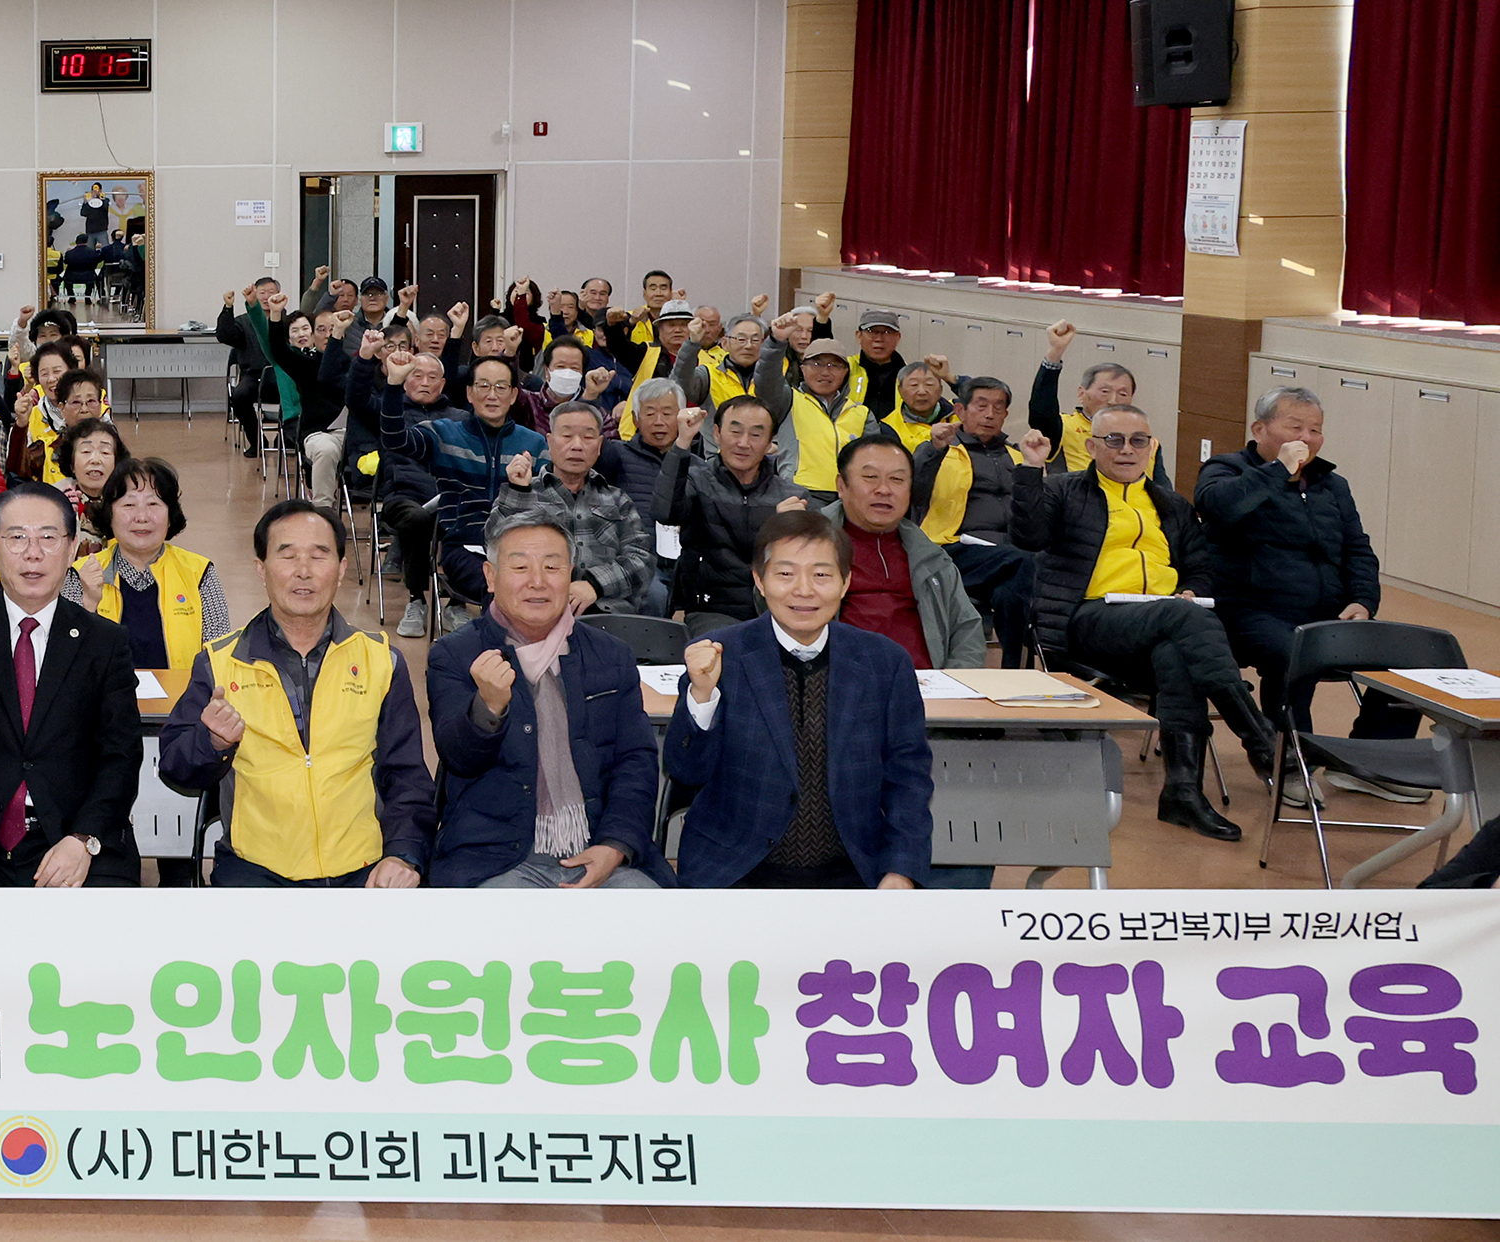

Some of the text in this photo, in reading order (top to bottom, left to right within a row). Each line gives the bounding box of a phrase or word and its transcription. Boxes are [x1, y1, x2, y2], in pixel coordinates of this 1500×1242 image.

[1214, 126, 1220, 136] 3
[1120, 911, 1271, 942] 보건복지부
[24, 959, 1480, 1096] 노인자원봉사 참여자 교육
[65, 1128, 698, 1186] (사) 대한노인회 괴산군지회
